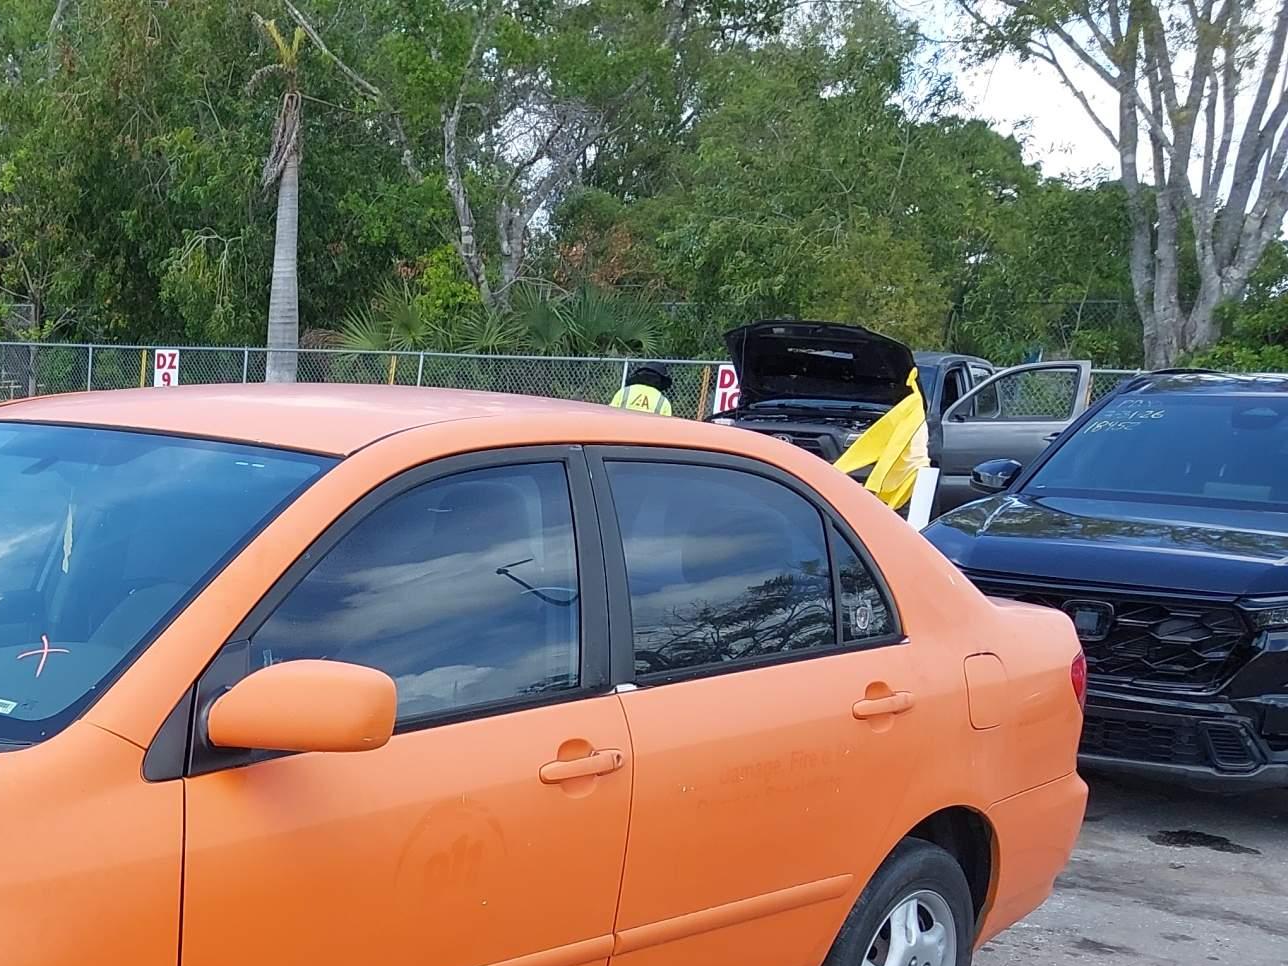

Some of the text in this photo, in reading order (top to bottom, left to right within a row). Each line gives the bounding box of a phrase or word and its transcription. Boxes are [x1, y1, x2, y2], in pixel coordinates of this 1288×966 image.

[156, 352, 177, 370] DZ
[161, 371, 171, 387] 9
[718, 368, 740, 390] D
